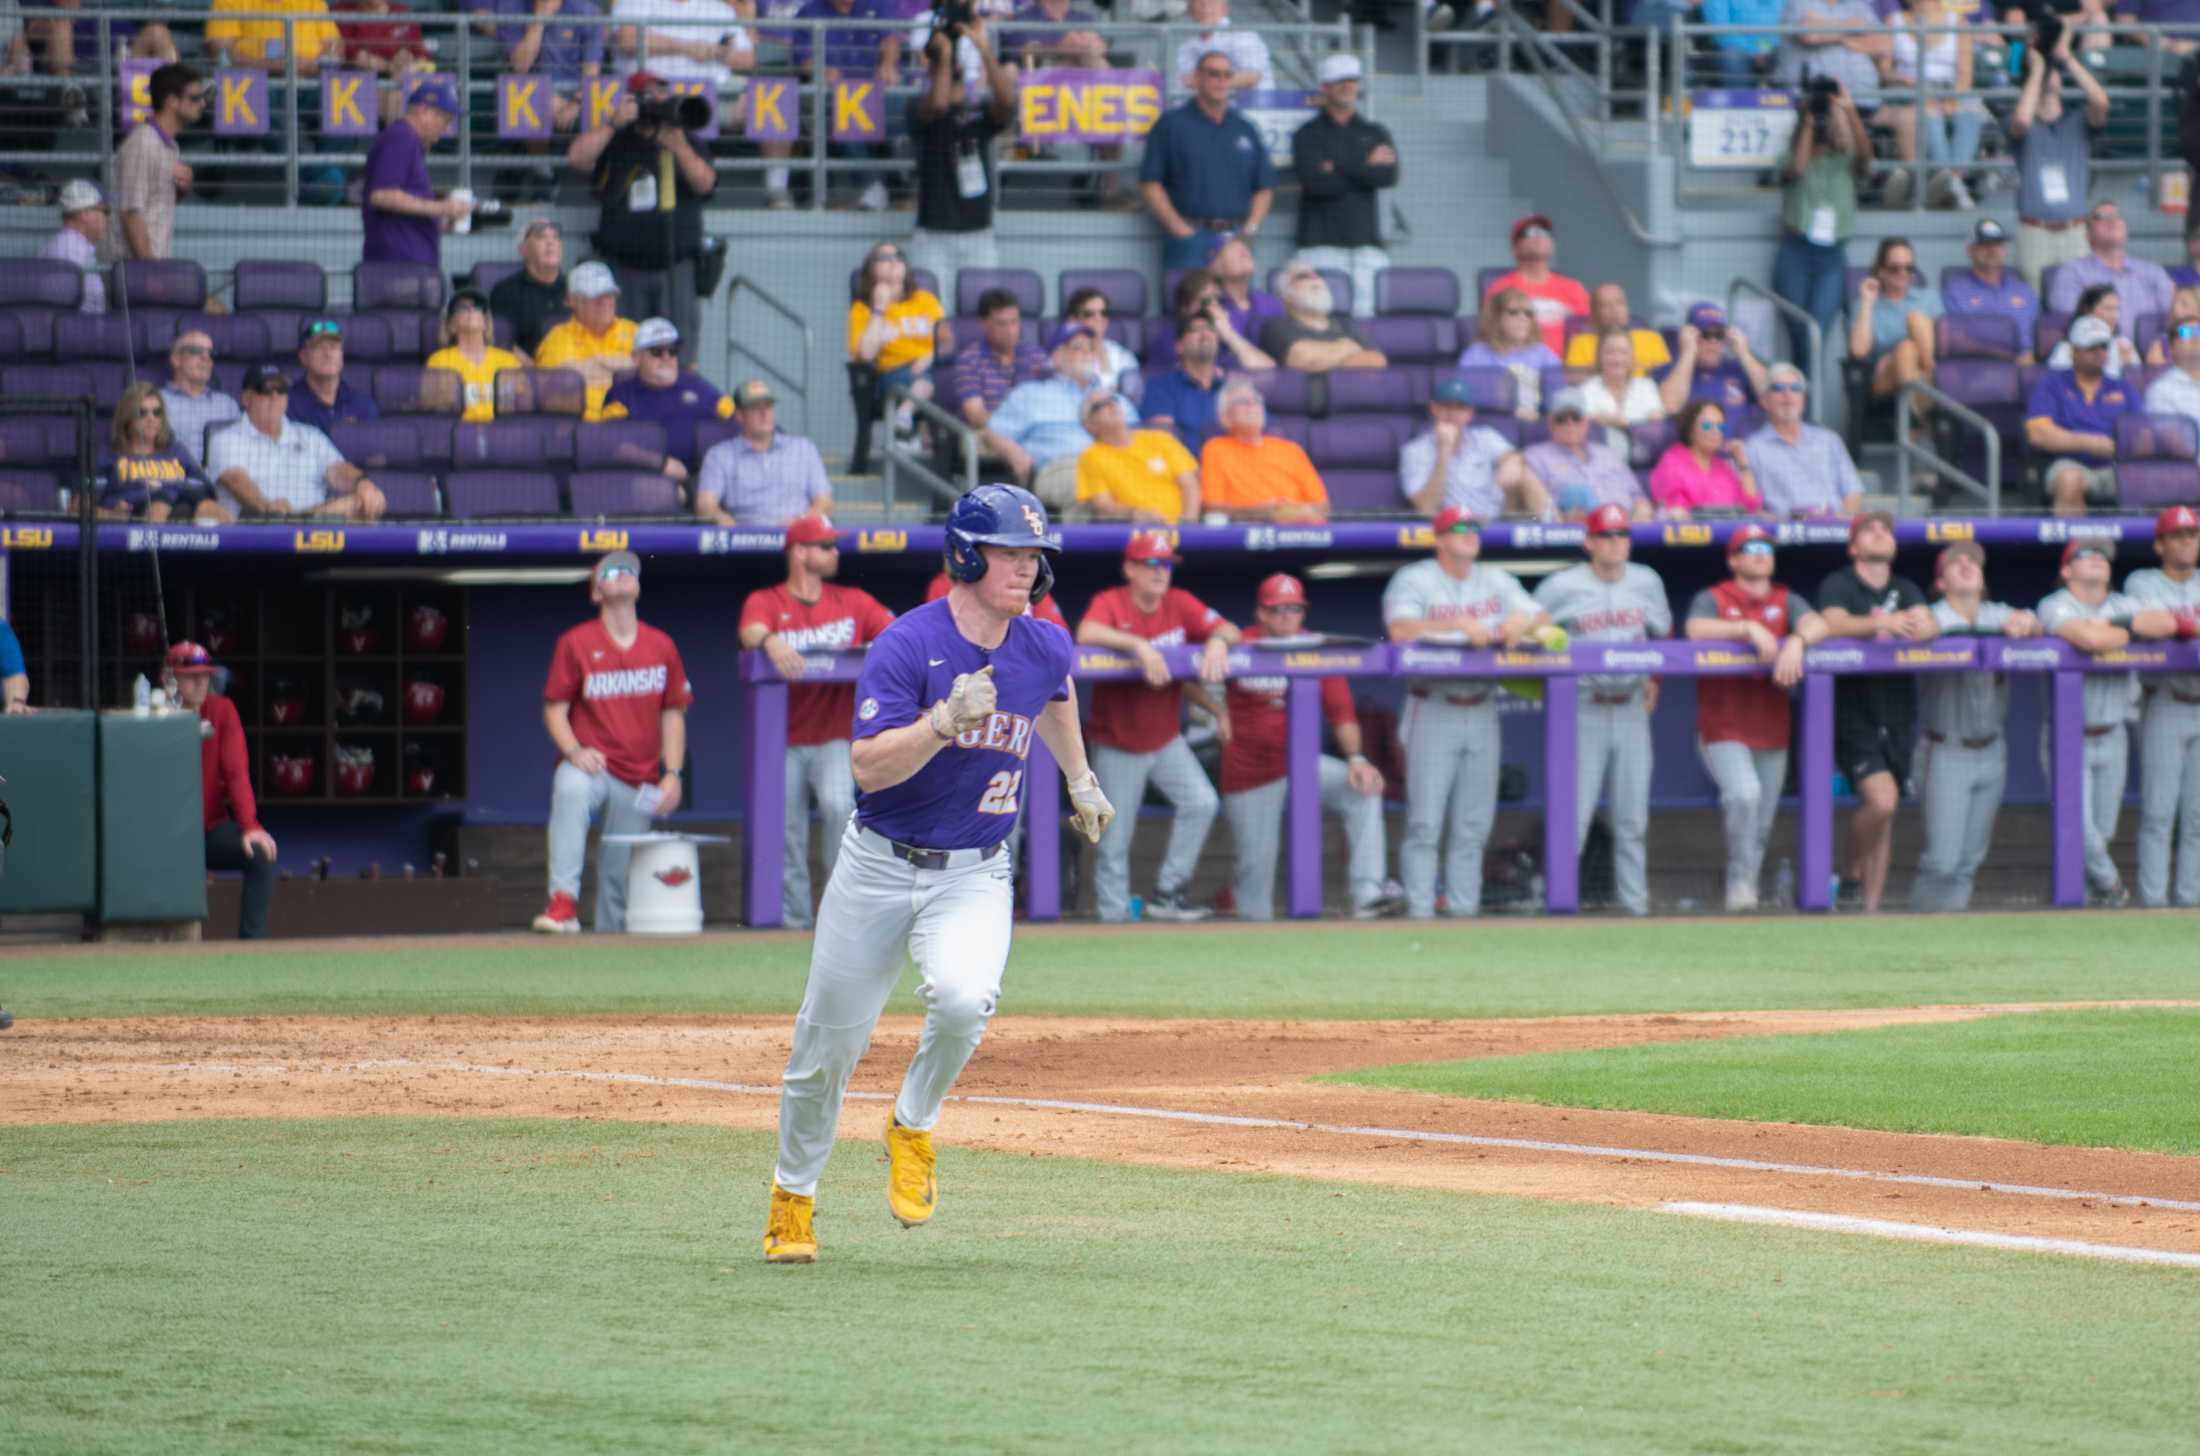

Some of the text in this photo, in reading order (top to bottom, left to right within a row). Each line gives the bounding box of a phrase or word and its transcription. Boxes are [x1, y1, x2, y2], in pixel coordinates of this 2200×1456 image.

[223, 77, 256, 125] K
[331, 77, 366, 126] K
[506, 80, 541, 129] K
[754, 83, 788, 132] K
[836, 83, 875, 133] K
[1021, 84, 1160, 135] ENES
[1720, 128, 1770, 153] 217
[1021, 504, 1043, 536] LSU
[1606, 506, 1622, 522] A
[2177, 507, 2194, 525] A
[2, 527, 53, 547] LSU
[161, 534, 220, 547] RENTALS
[295, 529, 345, 552] LSU
[450, 534, 507, 549] RENTALS
[579, 530, 629, 551] LSU
[858, 530, 907, 552] LSU
[1398, 527, 1436, 548] LS
[1664, 525, 1711, 545] LSU
[1926, 522, 1974, 542] LSU
[1155, 537, 1172, 549] A
[1278, 579, 1295, 594] A
[585, 665, 667, 698] ARKANSAS
